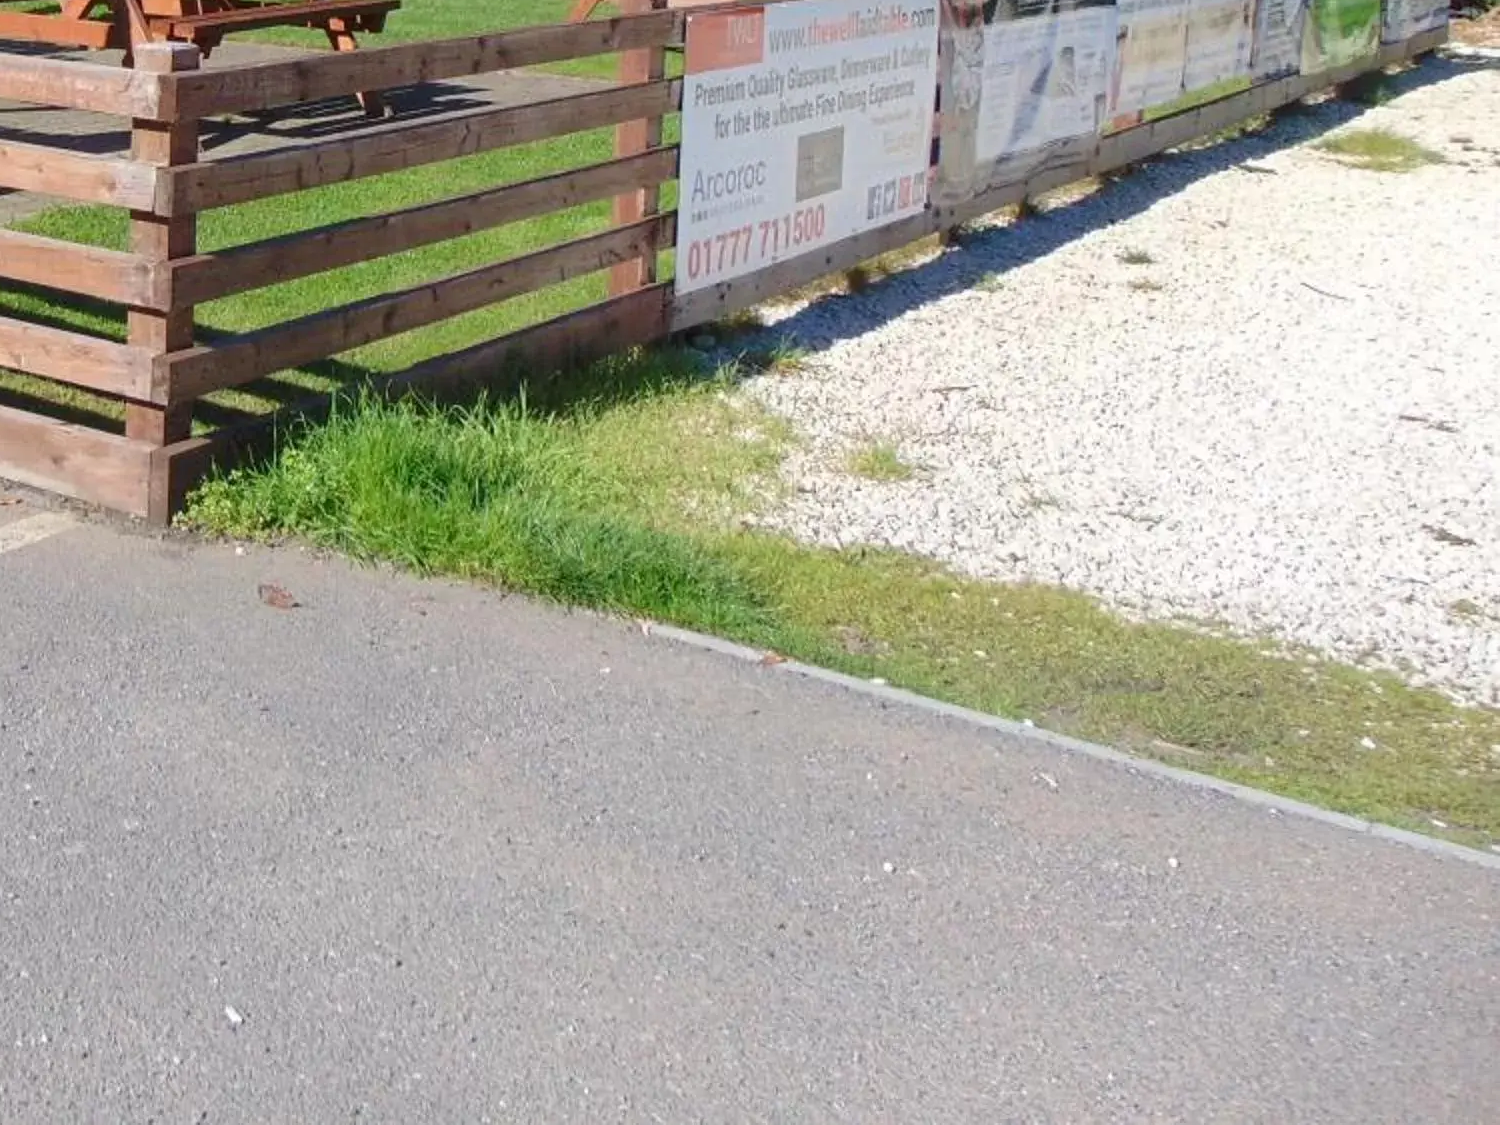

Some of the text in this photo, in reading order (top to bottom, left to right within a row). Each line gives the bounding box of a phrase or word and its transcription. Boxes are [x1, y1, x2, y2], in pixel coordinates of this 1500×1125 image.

[694, 81, 746, 108] Premium
[748, 73, 785, 99] Quality
[714, 80, 914, 139] for the the ultimate Fine Dining Experience
[691, 161, 767, 202] Arcoroc
[688, 221, 752, 281] 01777
[759, 203, 825, 258] 711500
